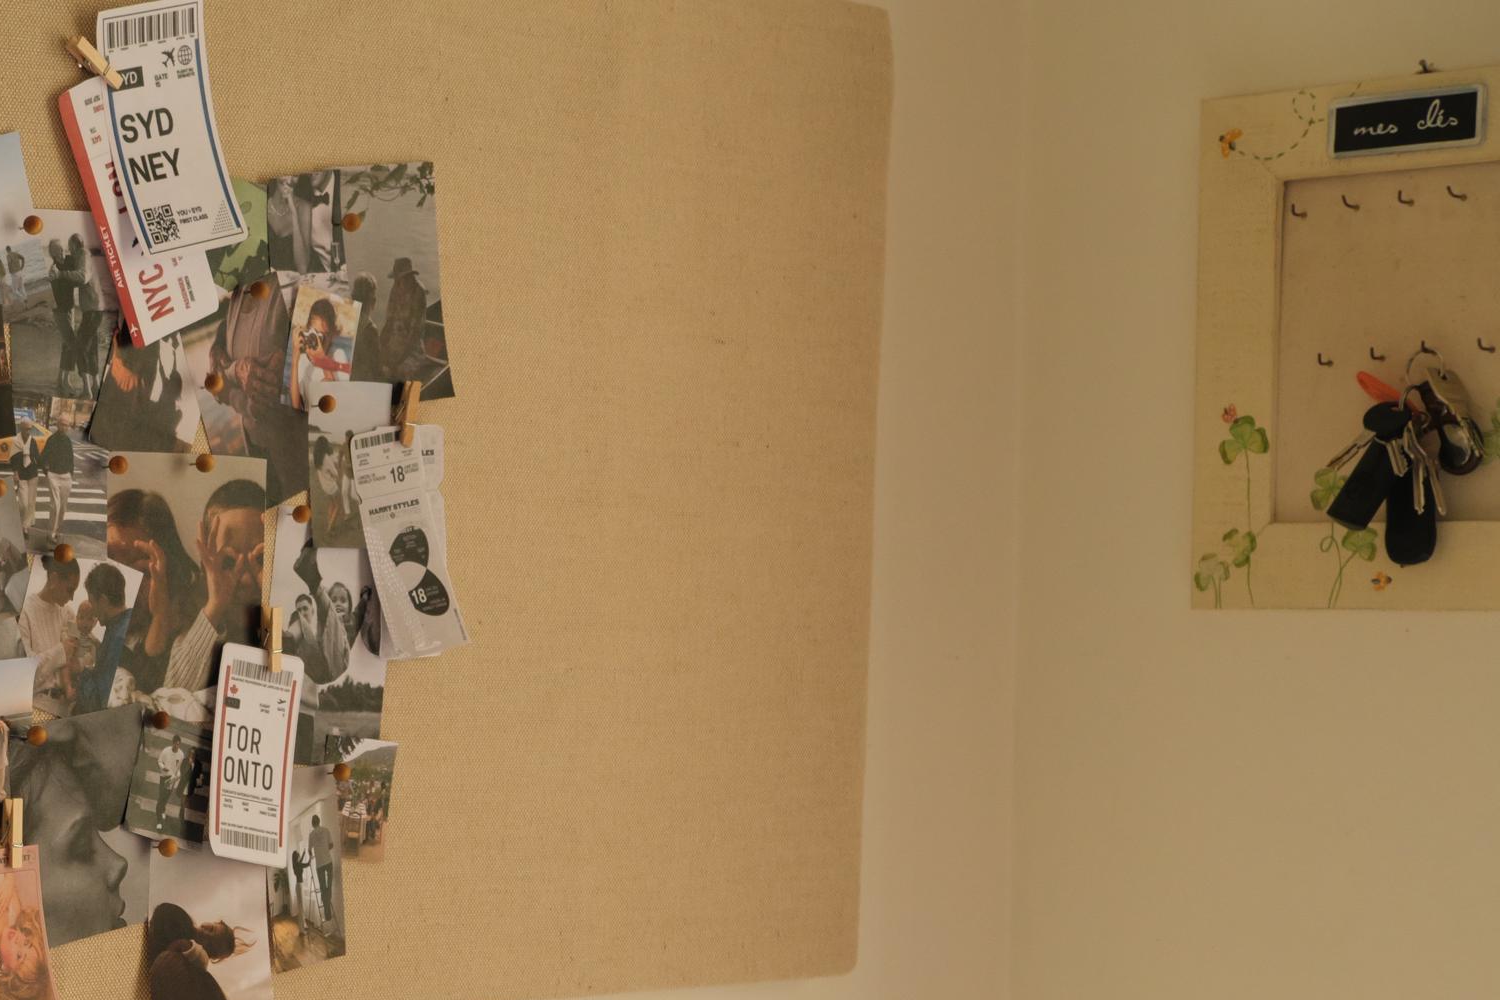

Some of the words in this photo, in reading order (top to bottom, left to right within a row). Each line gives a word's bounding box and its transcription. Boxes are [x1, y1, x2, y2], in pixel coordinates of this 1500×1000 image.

[121, 71, 138, 87] YD
[120, 107, 174, 144] SYD
[1353, 122, 1398, 136] mes
[1417, 98, 1459, 130] clés
[128, 148, 180, 185] NEY
[194, 212, 209, 222] CLASS
[99, 225, 120, 270] TICKET
[114, 273, 125, 289] AIR
[138, 263, 175, 322] NYC
[390, 465, 405, 484] 18
[368, 503, 392, 517] HARRY
[392, 498, 420, 511] STYLES
[411, 588, 427, 605] 18
[226, 722, 262, 755] TOR
[223, 755, 274, 791] ONTO
